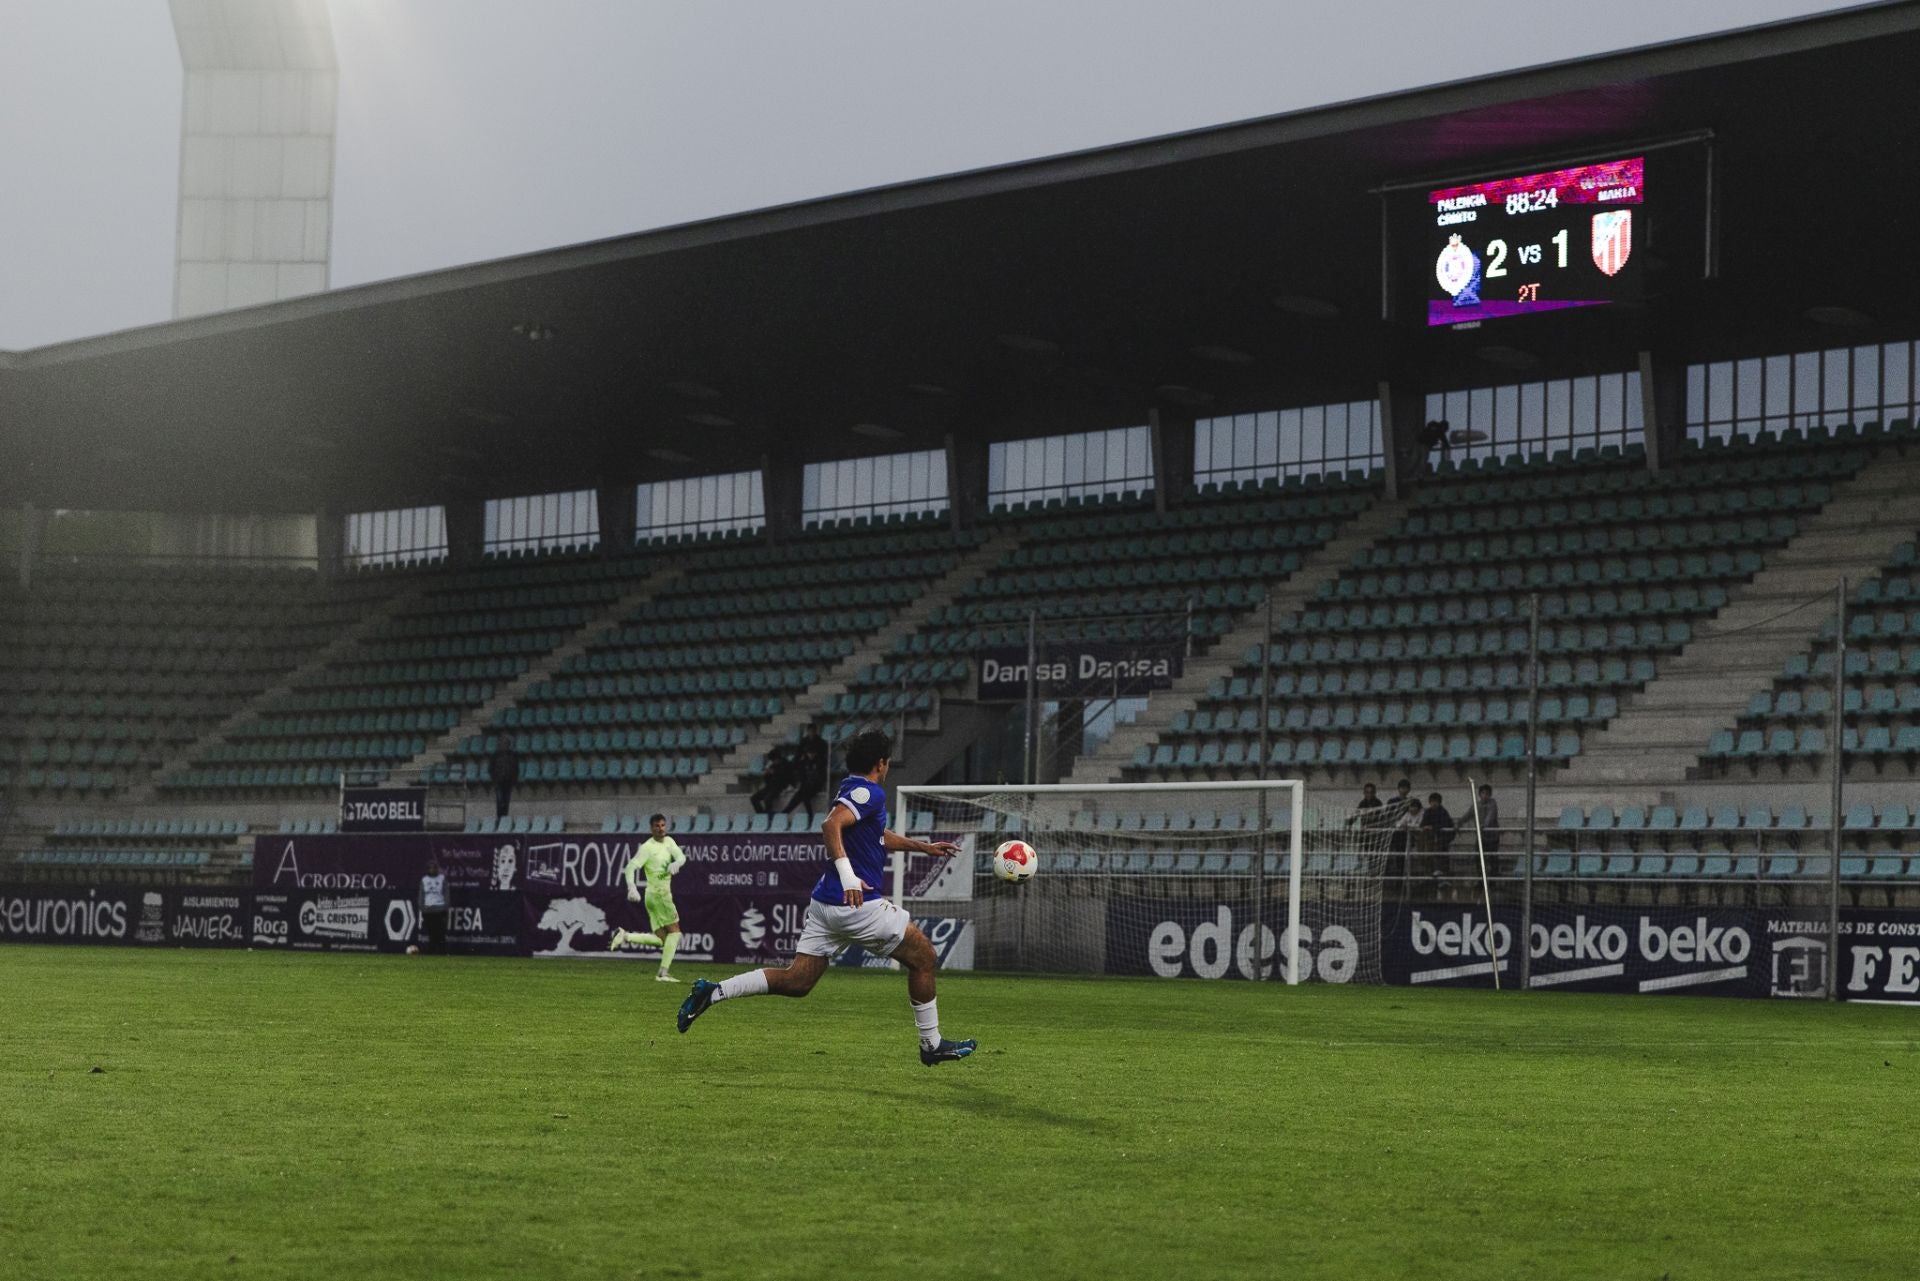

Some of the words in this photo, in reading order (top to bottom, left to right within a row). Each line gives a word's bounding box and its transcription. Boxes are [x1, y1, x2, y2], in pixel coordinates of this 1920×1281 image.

[1486, 239, 1508, 278] 2
[1552, 229, 1568, 268] 1
[1518, 283, 1541, 303] 2T
[982, 659, 1067, 684] Dansa
[355, 801, 388, 820] TACO
[389, 801, 421, 820] BELL
[273, 839, 387, 889] ACRODECO
[720, 845, 730, 862] &
[733, 844, 832, 862] COMPLEMENT
[8, 888, 127, 938] euronics
[182, 896, 239, 909] AISLAMIENTOS
[172, 914, 232, 940] JAVIER
[253, 914, 288, 935] Roca
[316, 913, 325, 923] EL
[327, 912, 358, 925] CRISTO
[772, 903, 808, 935] SIL
[1767, 920, 1853, 935] MATERIAES
[1856, 922, 1875, 935] DE
[774, 935, 797, 951] CLÍ
[1148, 905, 1359, 984] edesa
[1411, 911, 1512, 958] beko
[1639, 916, 1751, 963] beko
[1846, 945, 1920, 993] FE
